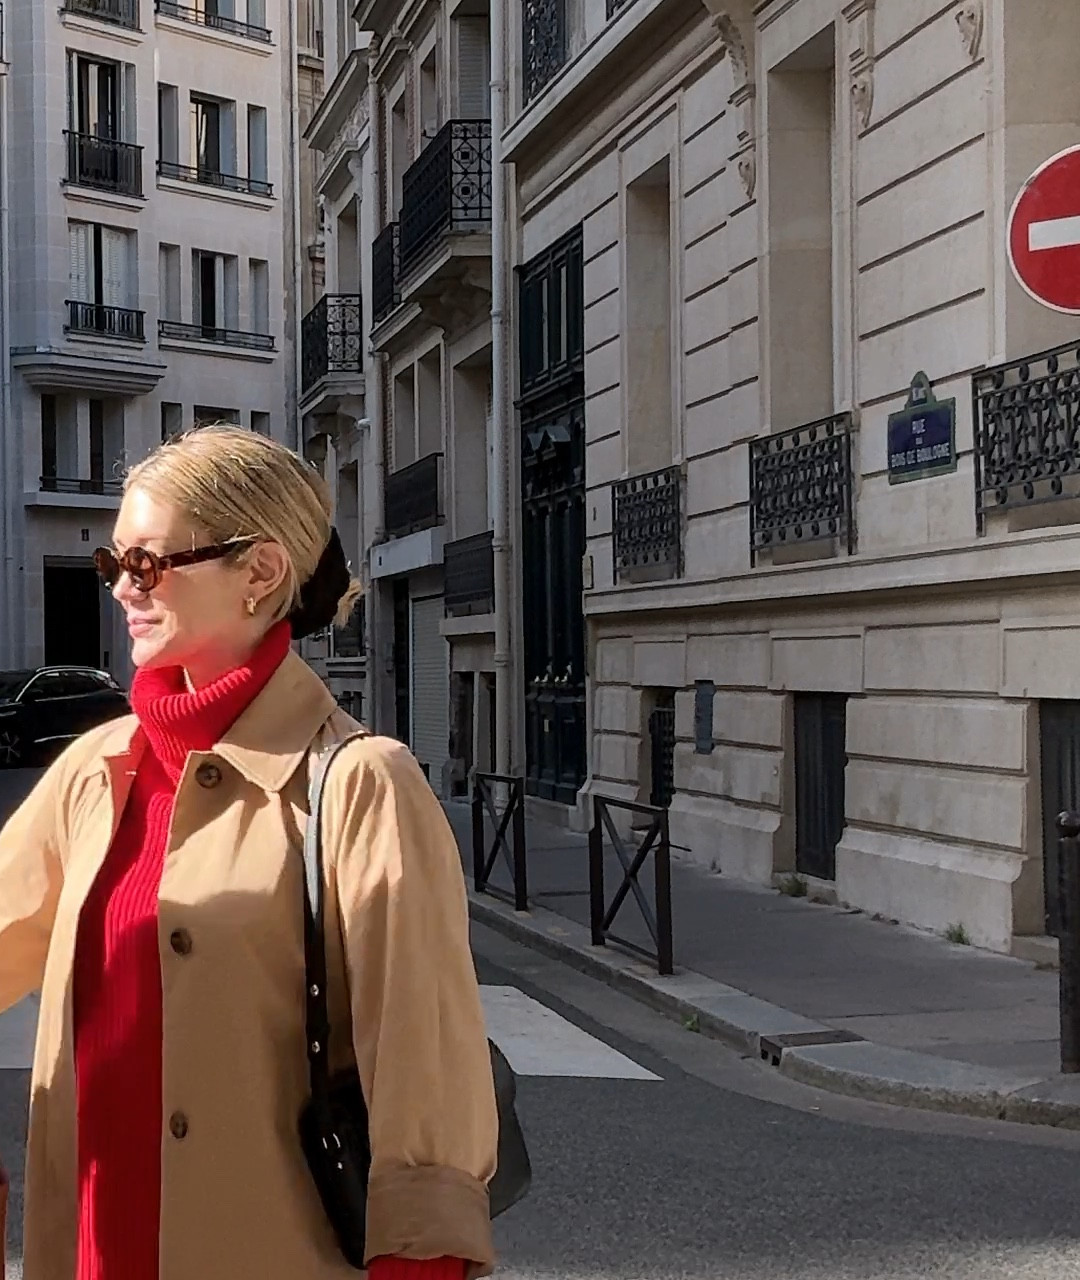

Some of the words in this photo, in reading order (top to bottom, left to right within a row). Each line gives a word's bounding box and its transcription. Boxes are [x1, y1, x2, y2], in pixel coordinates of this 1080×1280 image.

[912, 418, 926, 434] RUE
[907, 449, 916, 465] DE
[916, 442, 950, 463] BOULOGNE
